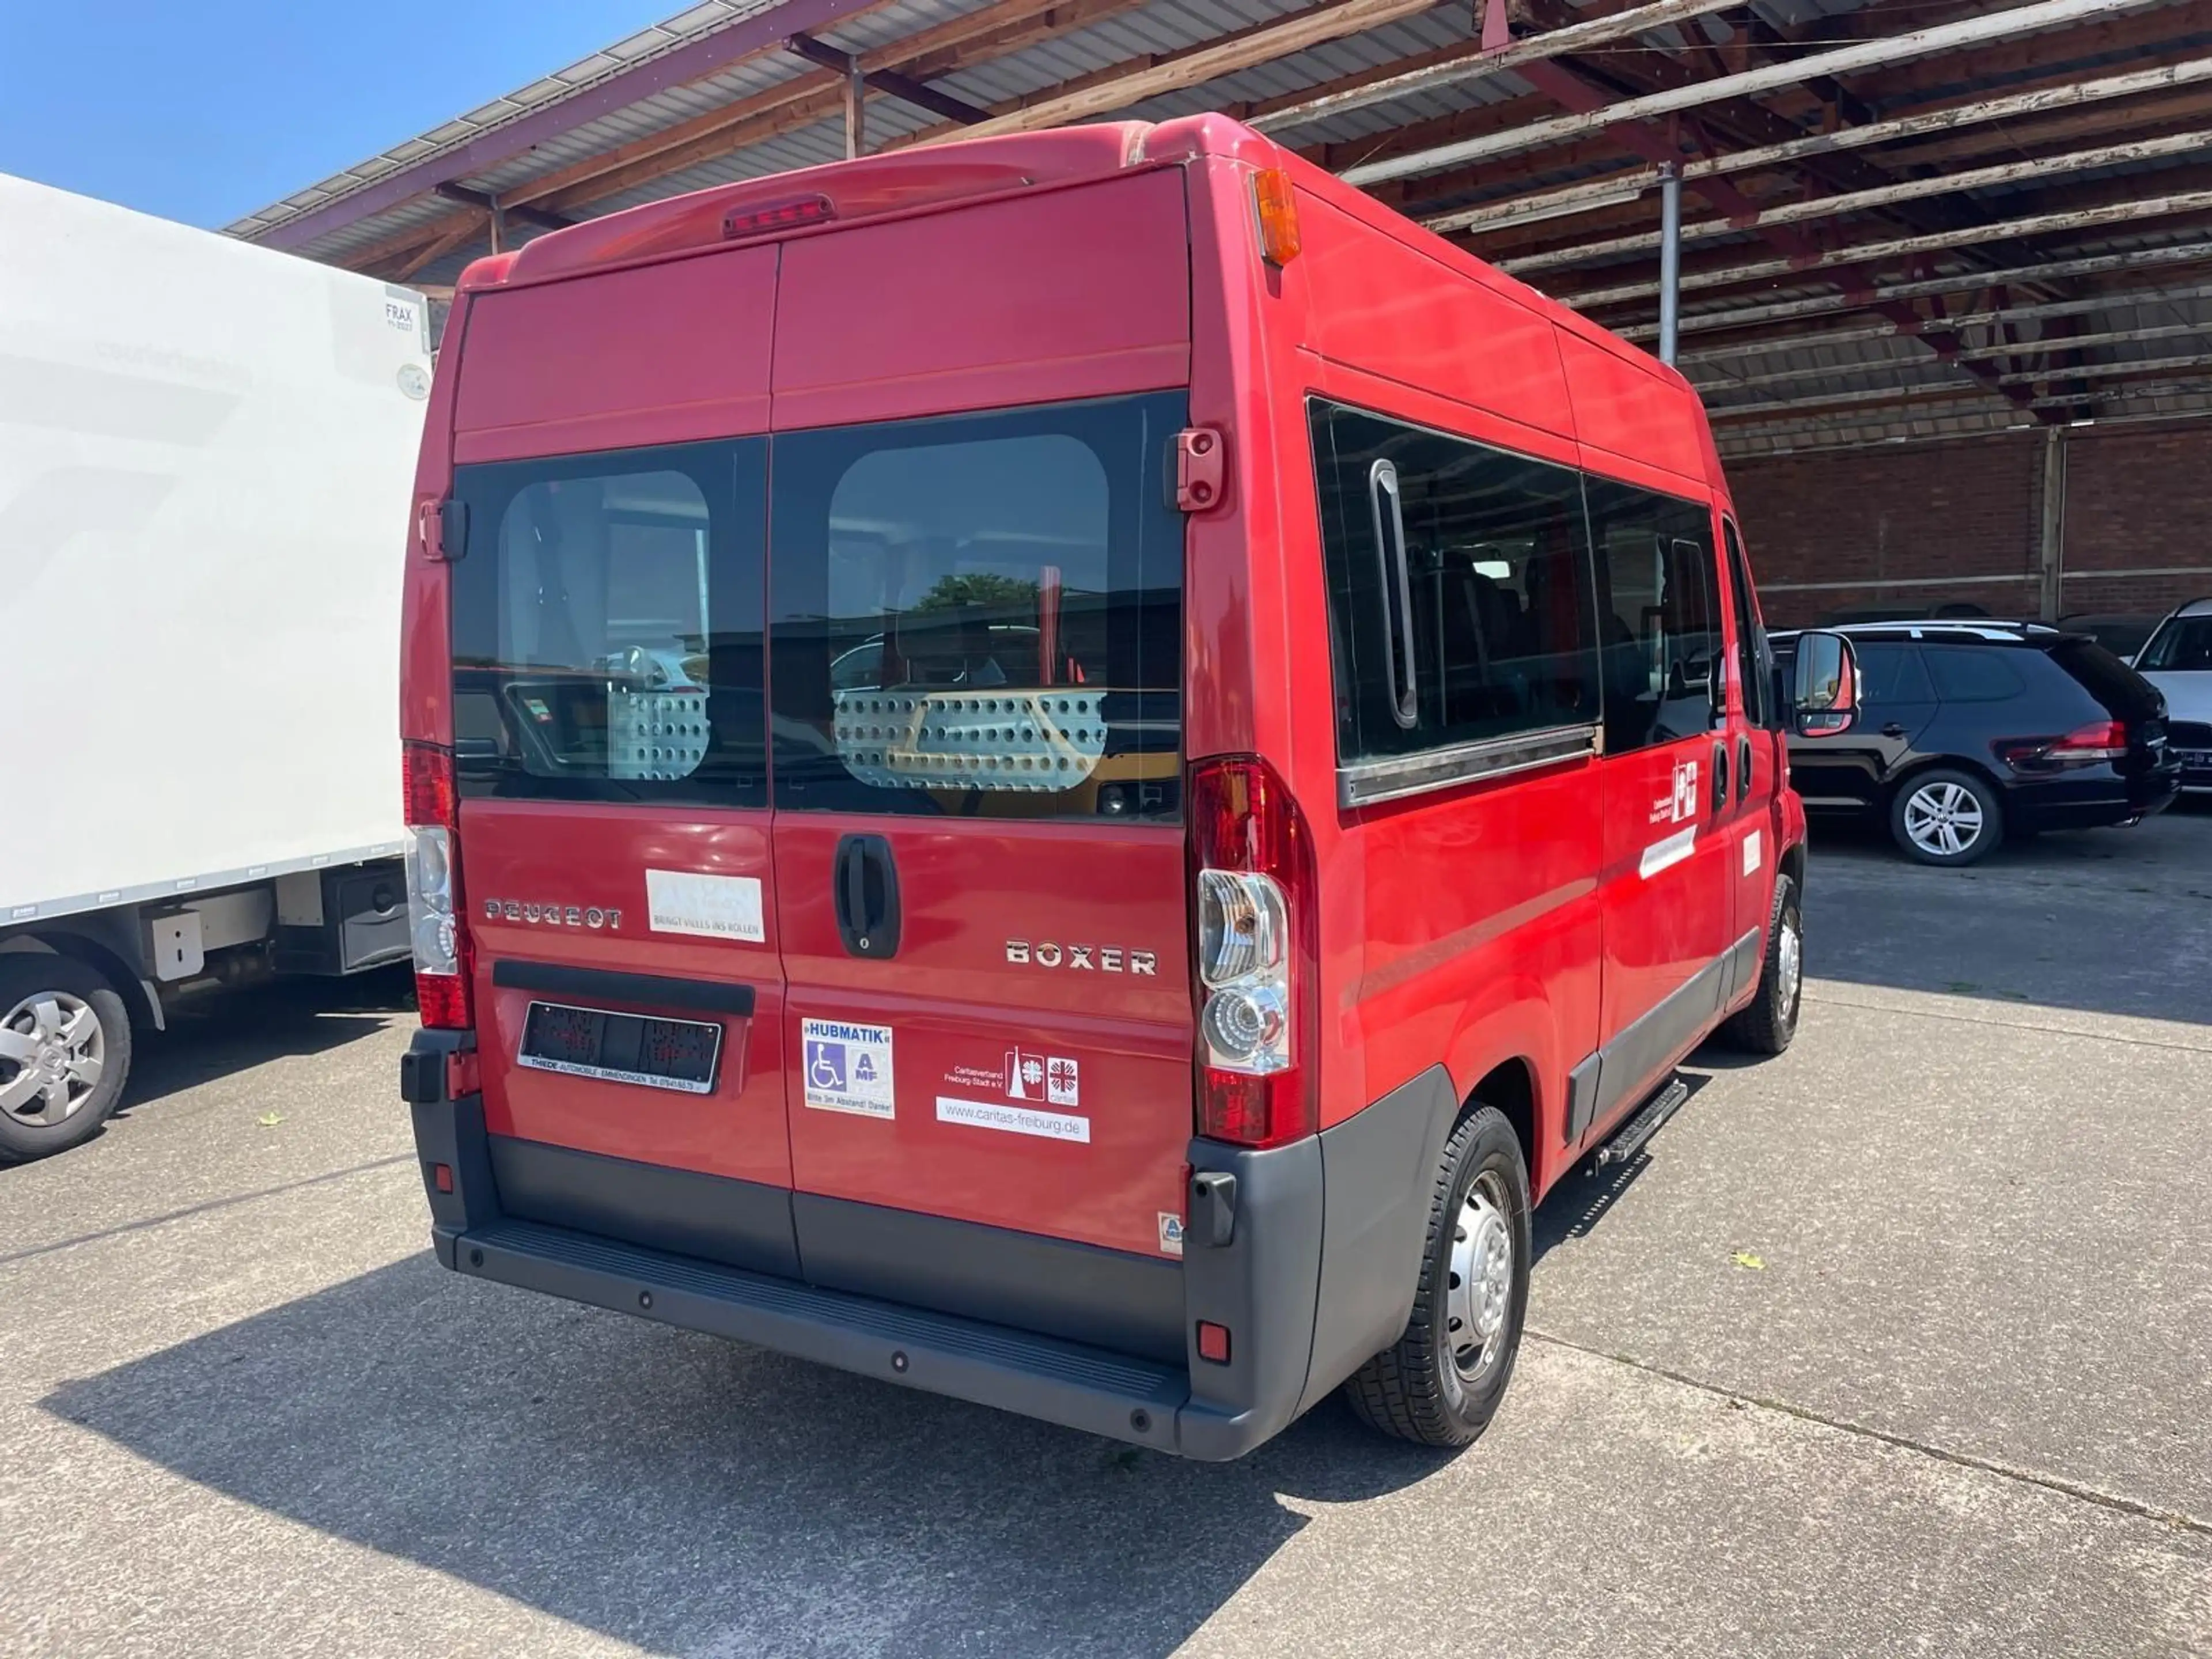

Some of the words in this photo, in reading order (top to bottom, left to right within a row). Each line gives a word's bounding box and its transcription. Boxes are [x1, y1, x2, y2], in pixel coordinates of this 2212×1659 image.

[386, 304, 412, 322] FRAX
[484, 899, 622, 929] PEUGEOT
[1006, 940, 1157, 976] BOXER
[945, 1105, 1080, 1135] www.caritas-freiburg.de
